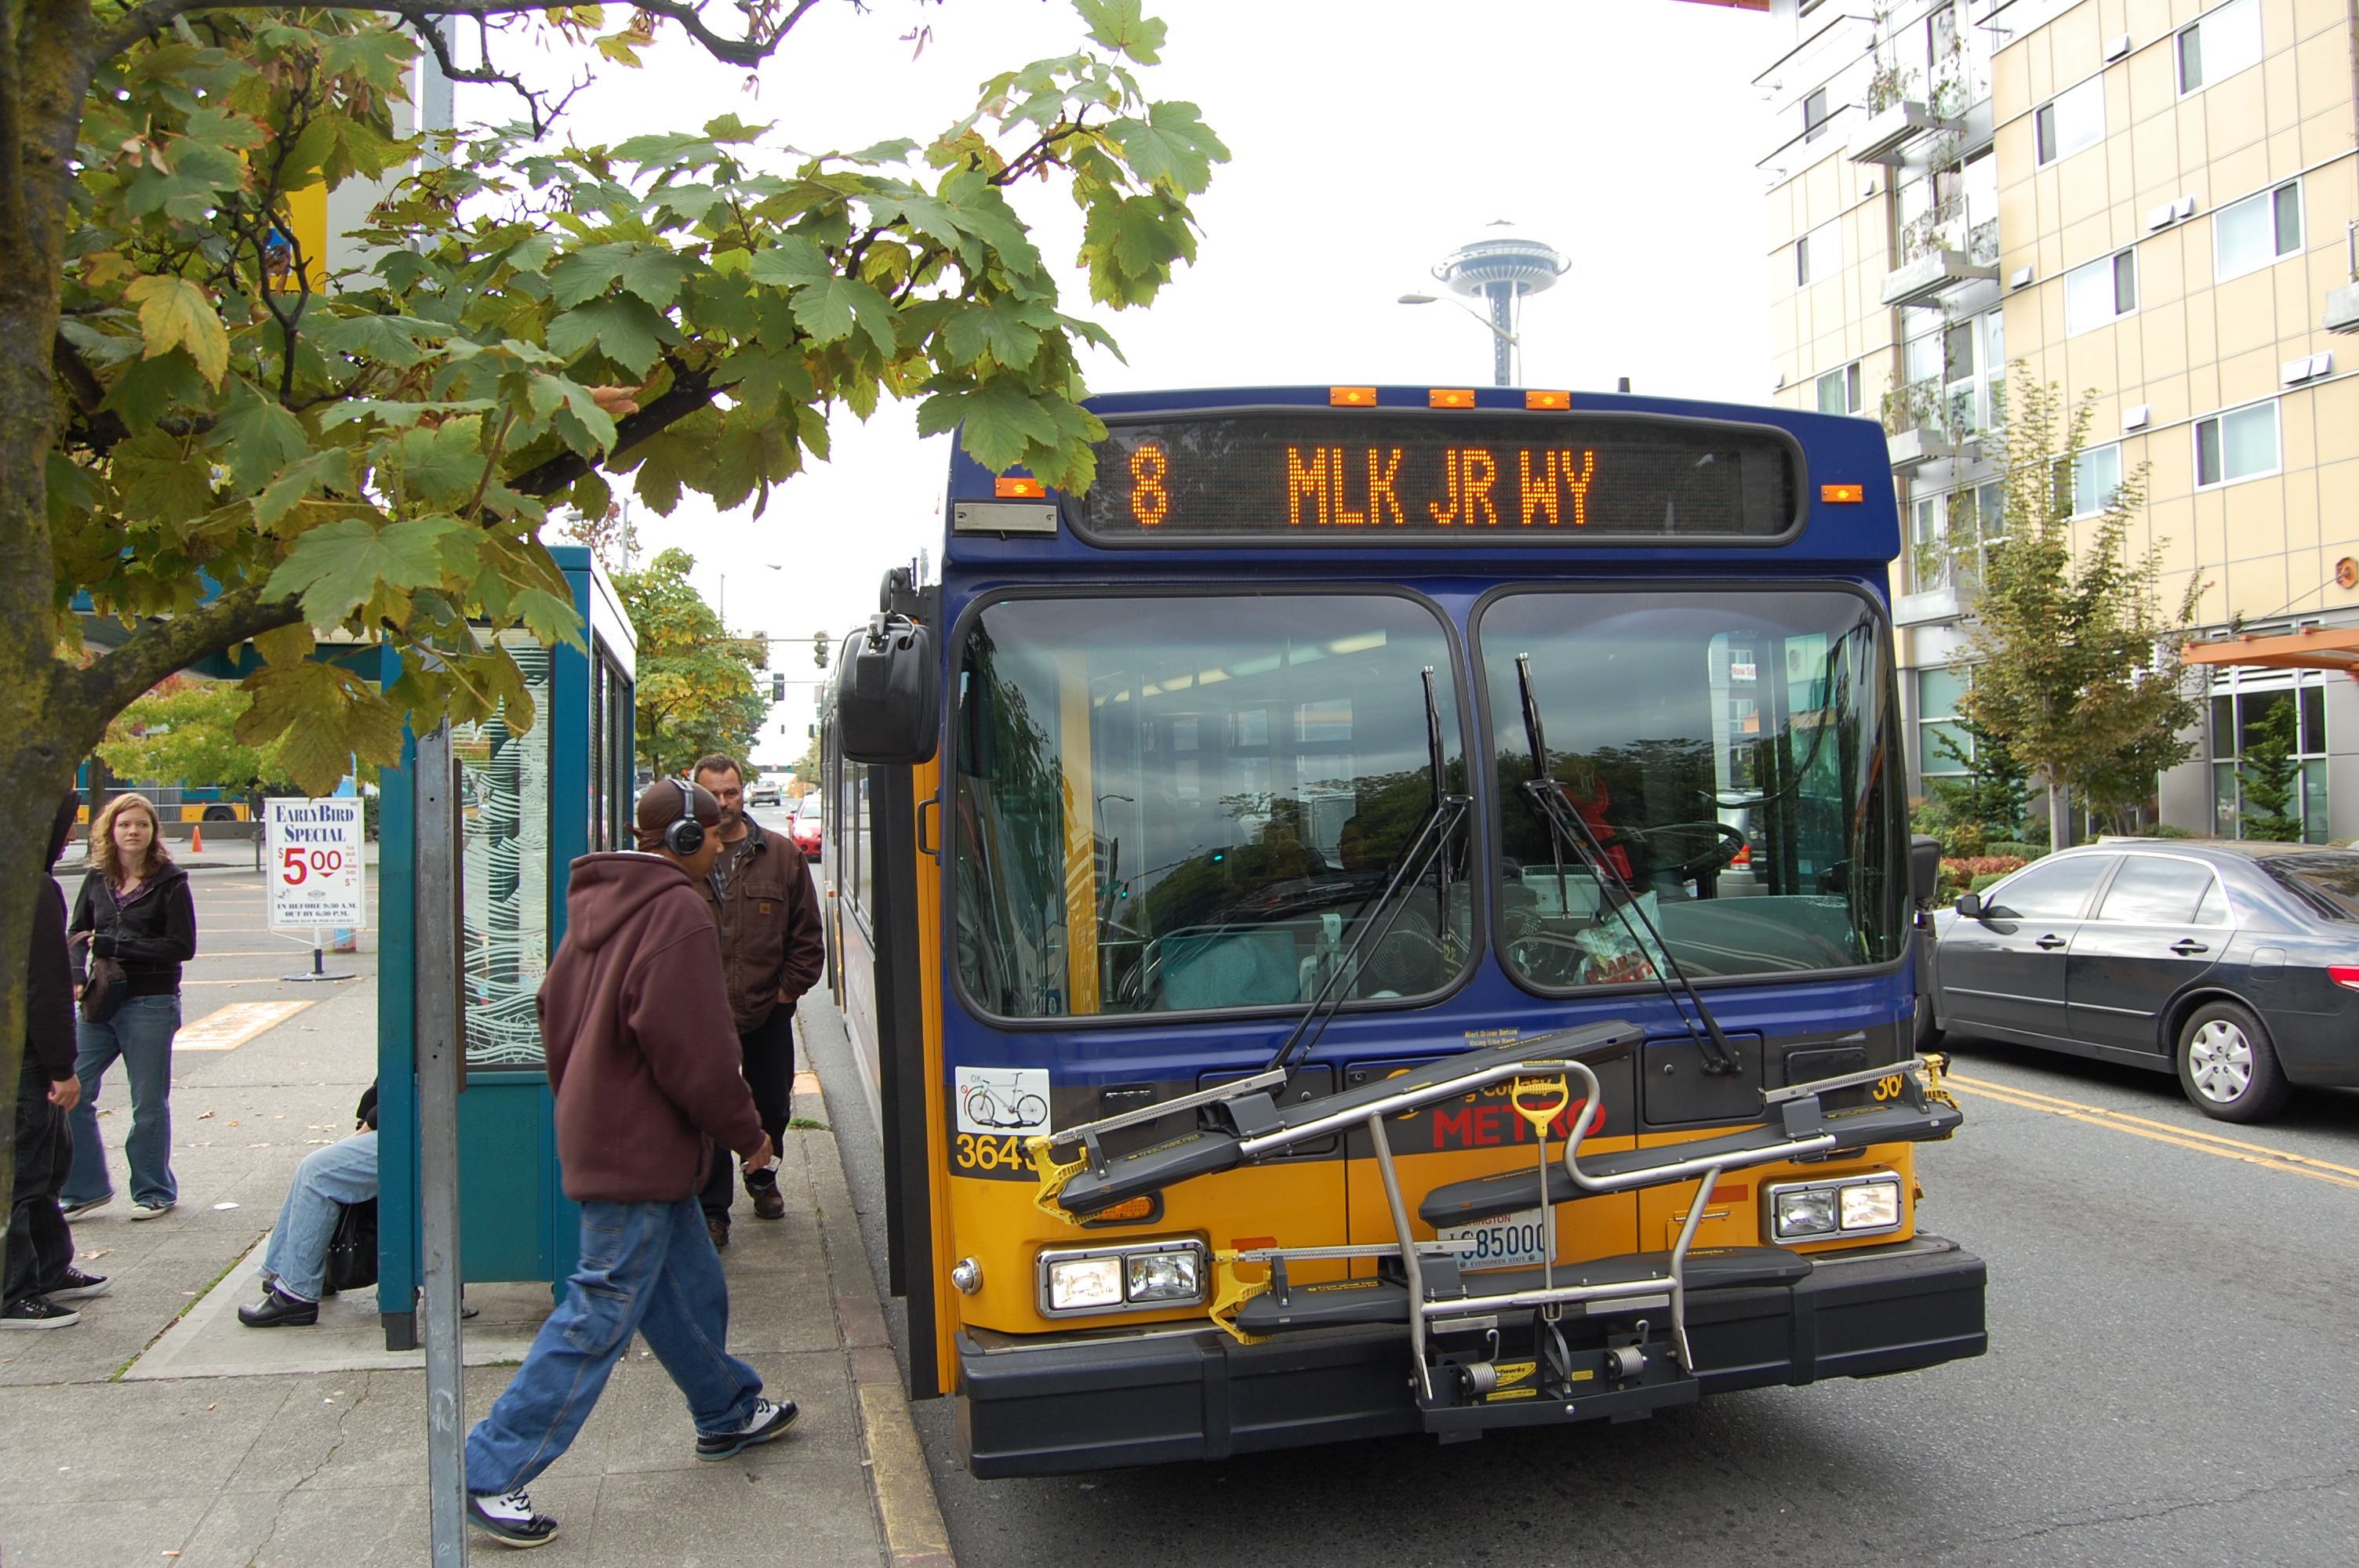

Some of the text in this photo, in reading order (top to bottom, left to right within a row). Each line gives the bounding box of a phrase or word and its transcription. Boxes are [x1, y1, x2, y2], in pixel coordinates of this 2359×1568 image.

[1131, 445, 1594, 524] 8 MLK JR WY
[285, 824, 346, 842] SPECIAL
[970, 1074, 982, 1083] OK
[1434, 1098, 1606, 1149] METRO
[1459, 1214, 1511, 1227] INGTON
[1470, 1258, 1506, 1267] EVERGREEN
